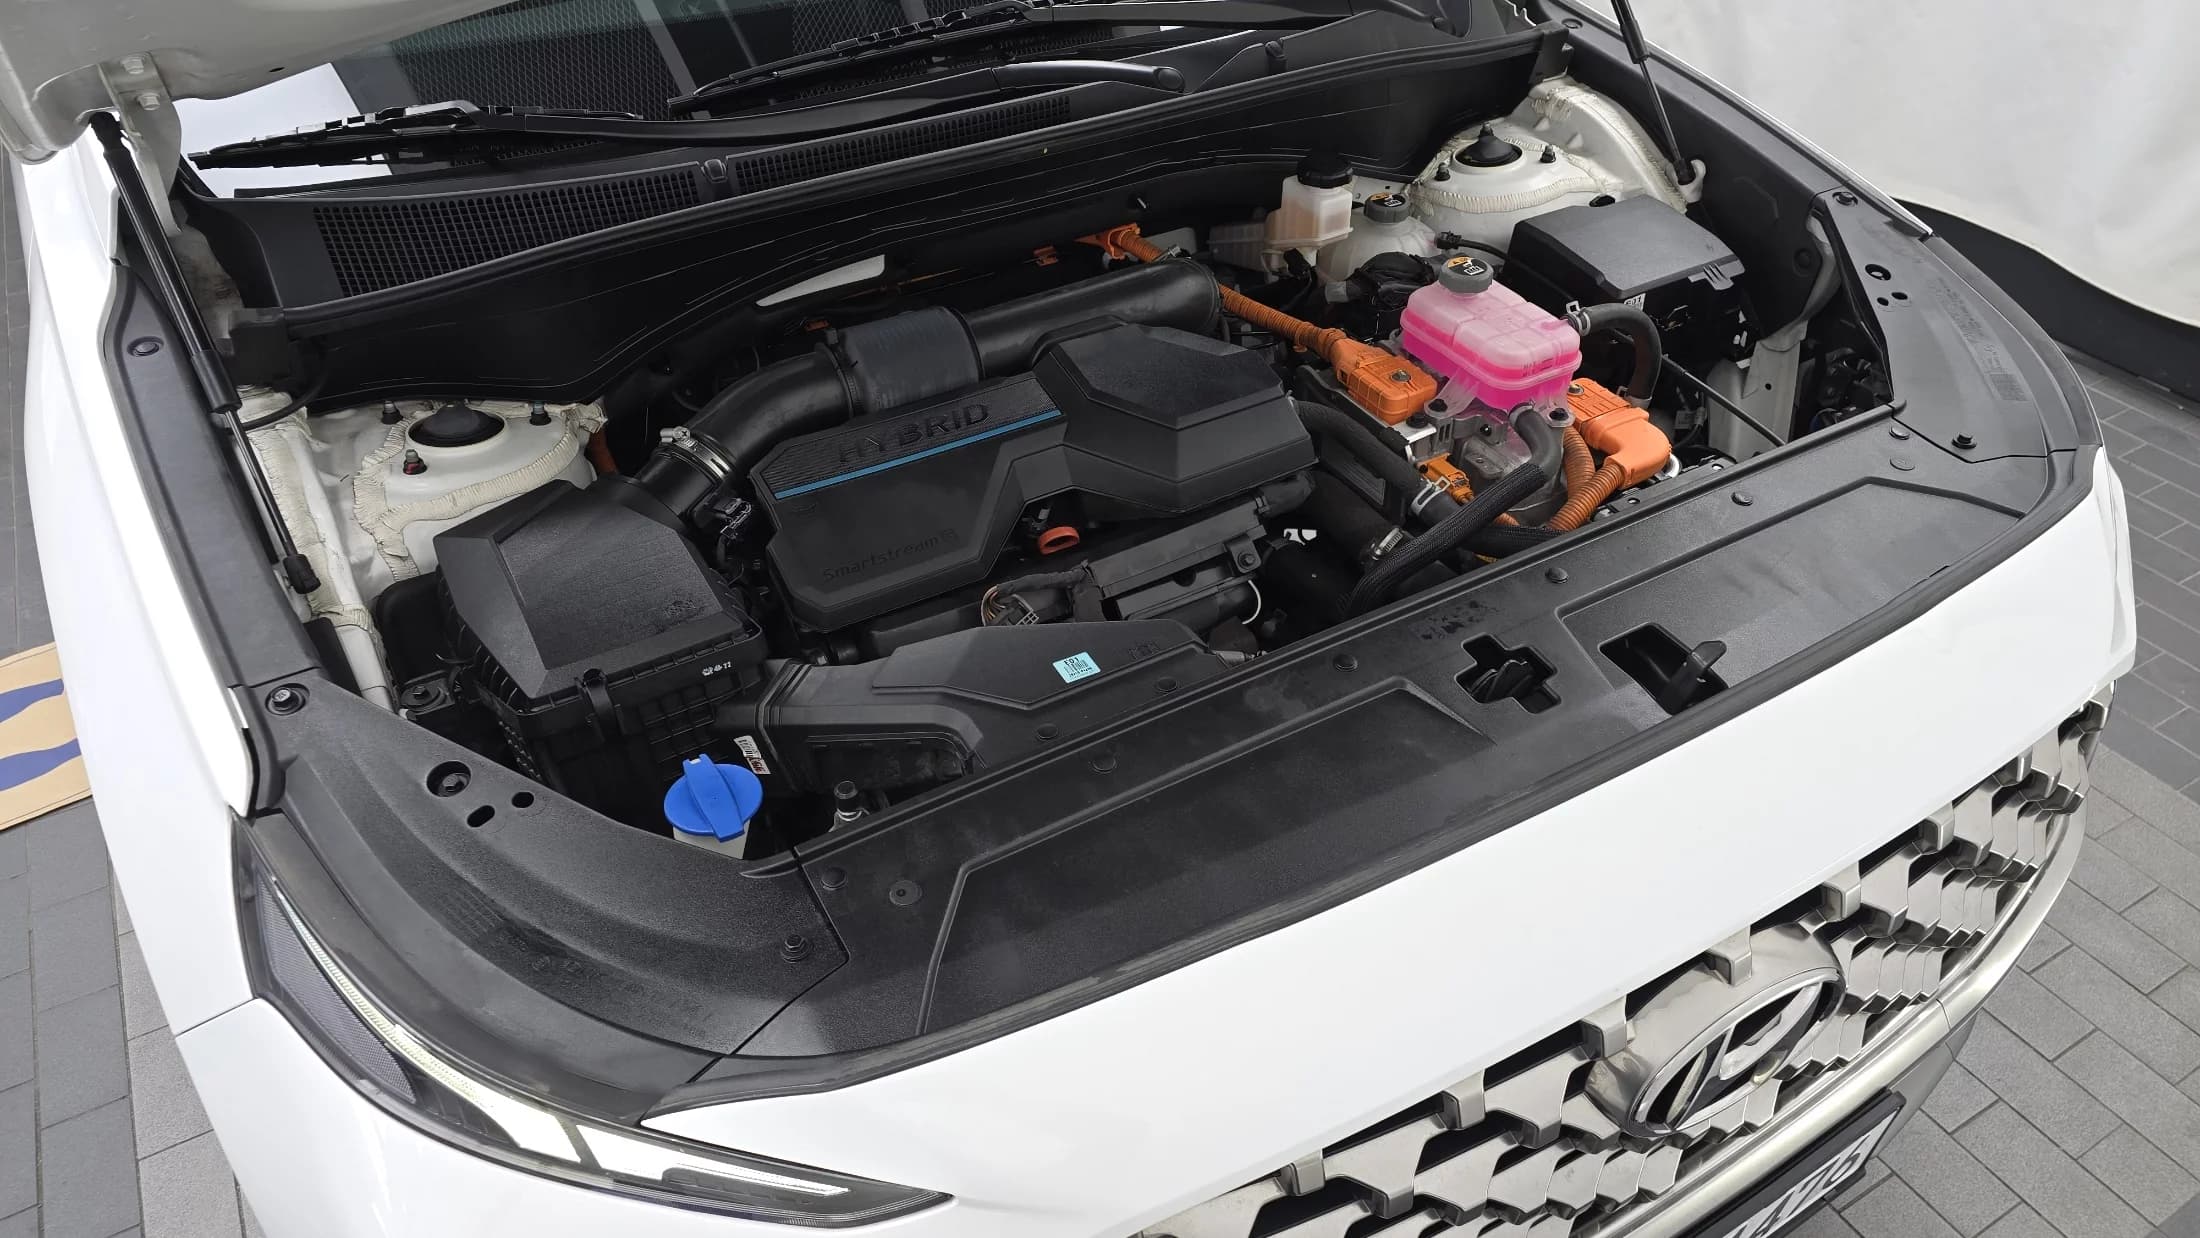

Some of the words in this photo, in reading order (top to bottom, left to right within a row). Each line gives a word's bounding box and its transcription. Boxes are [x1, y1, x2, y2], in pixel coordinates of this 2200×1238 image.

[838, 404, 989, 463] HYBRID
[823, 536, 939, 580] Smartstream
[1733, 1133, 1872, 1238] 476
